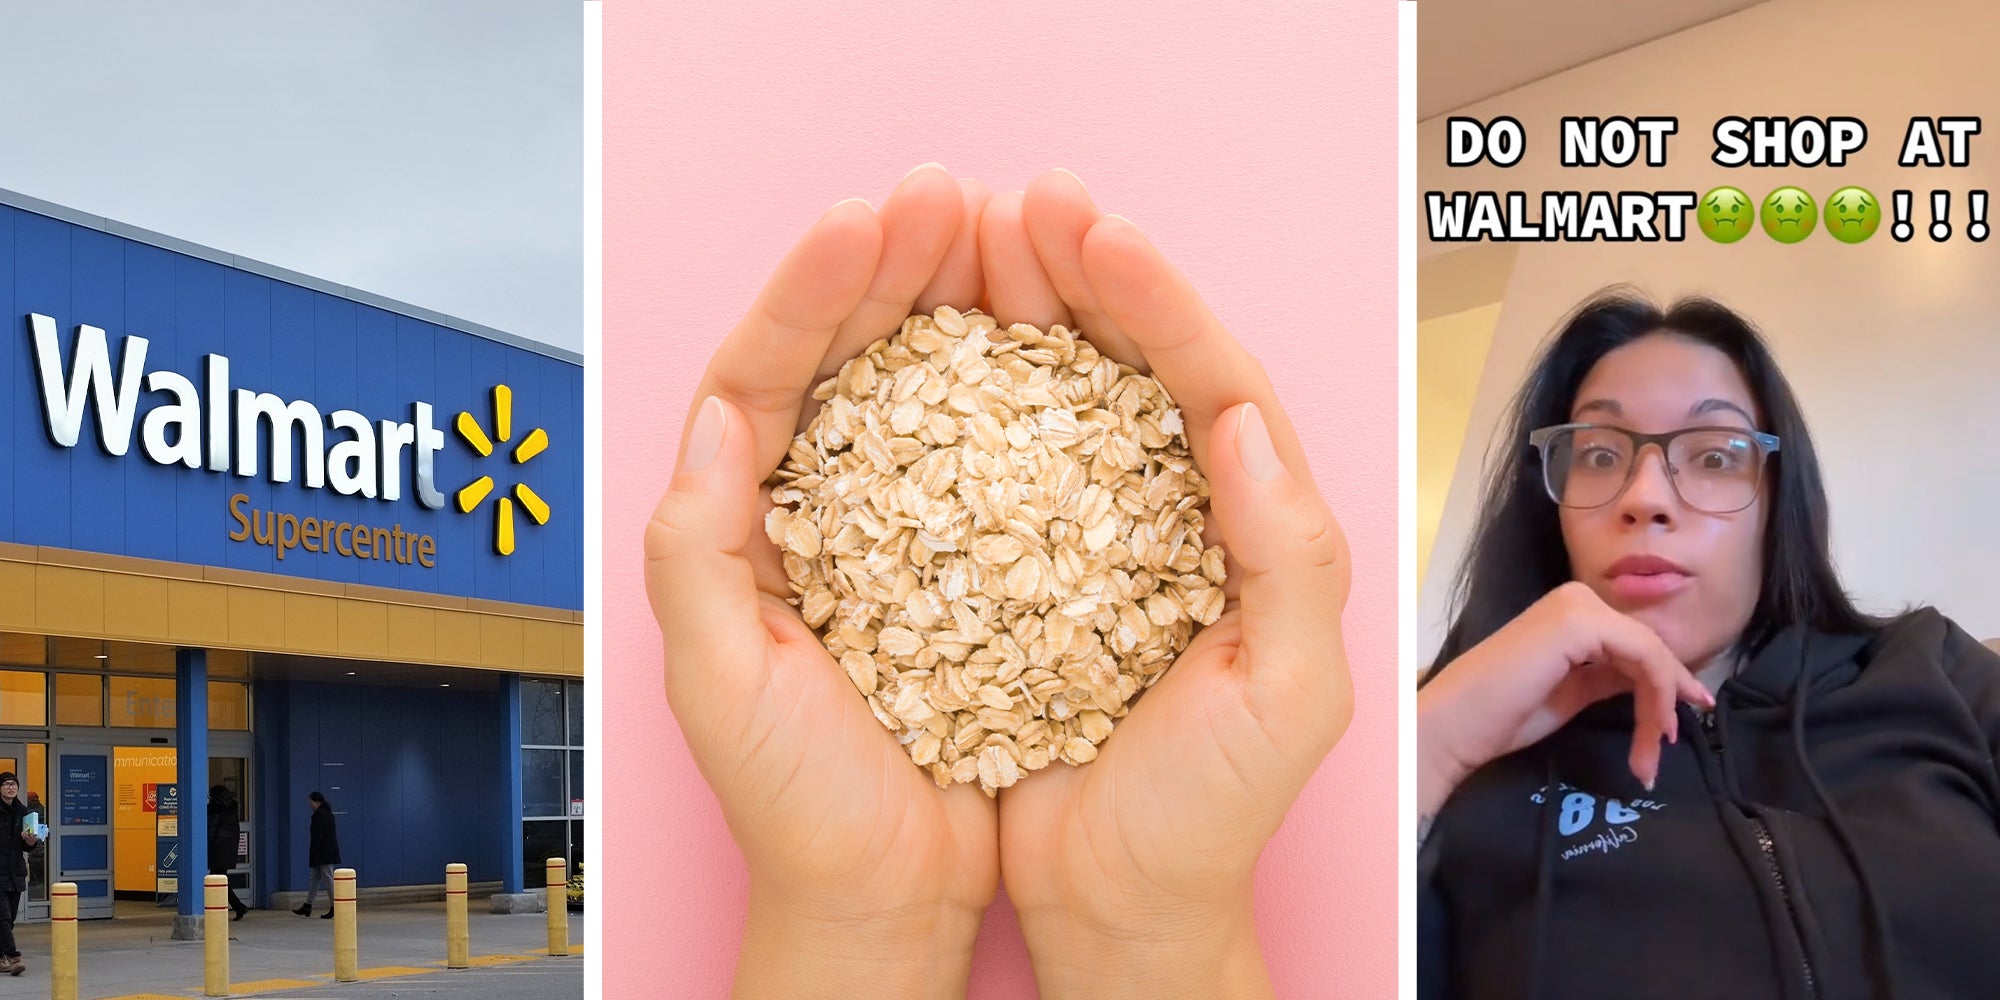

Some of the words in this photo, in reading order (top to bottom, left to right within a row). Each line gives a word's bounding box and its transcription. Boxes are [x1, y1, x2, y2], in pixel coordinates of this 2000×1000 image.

[26, 312, 444, 510] Walmart
[229, 493, 436, 567] Supercentre
[127, 690, 177, 719] Ente
